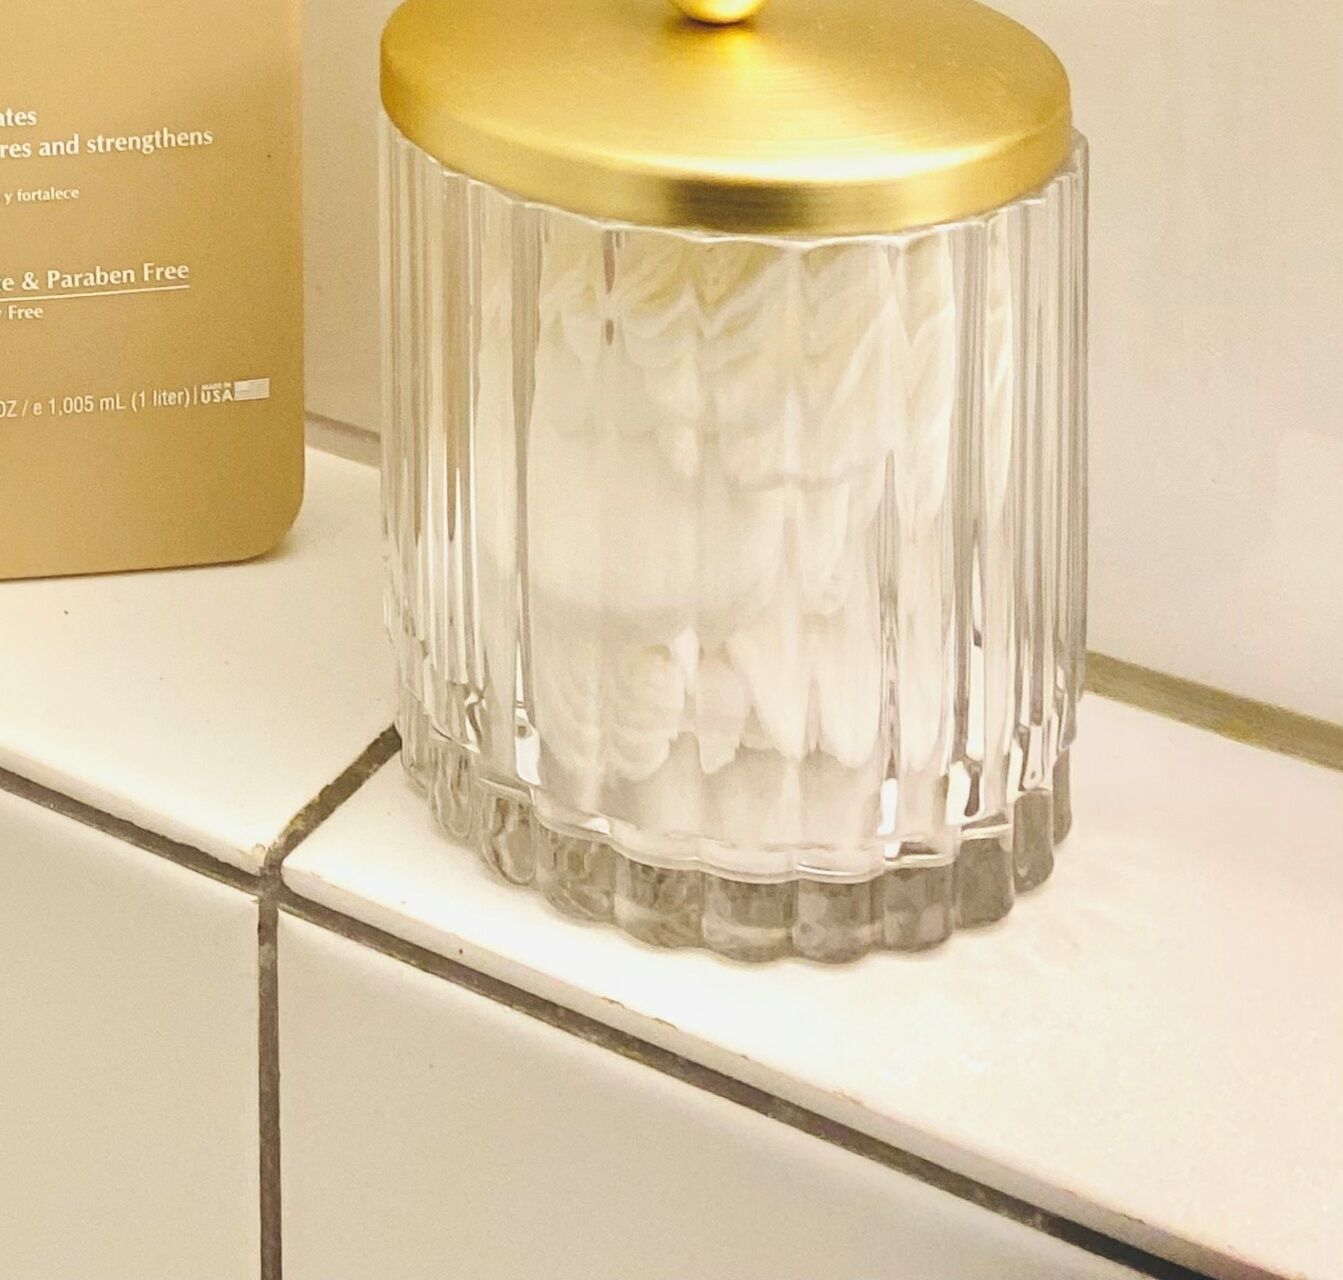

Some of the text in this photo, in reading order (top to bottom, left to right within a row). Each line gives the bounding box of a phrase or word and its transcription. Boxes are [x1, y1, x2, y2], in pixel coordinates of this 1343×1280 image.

[38, 132, 80, 157] and
[86, 127, 214, 156] strengthens
[4, 193, 13, 205] y
[17, 186, 80, 203] fortalece
[21, 273, 40, 291] &
[47, 265, 136, 290] Paraben
[143, 262, 190, 283] Free
[8, 304, 44, 320] Free
[48, 394, 94, 417] 1,005
[99, 393, 126, 411] mL
[131, 390, 146, 412] (1
[152, 387, 190, 409] liter)
[200, 389, 234, 404] USA
